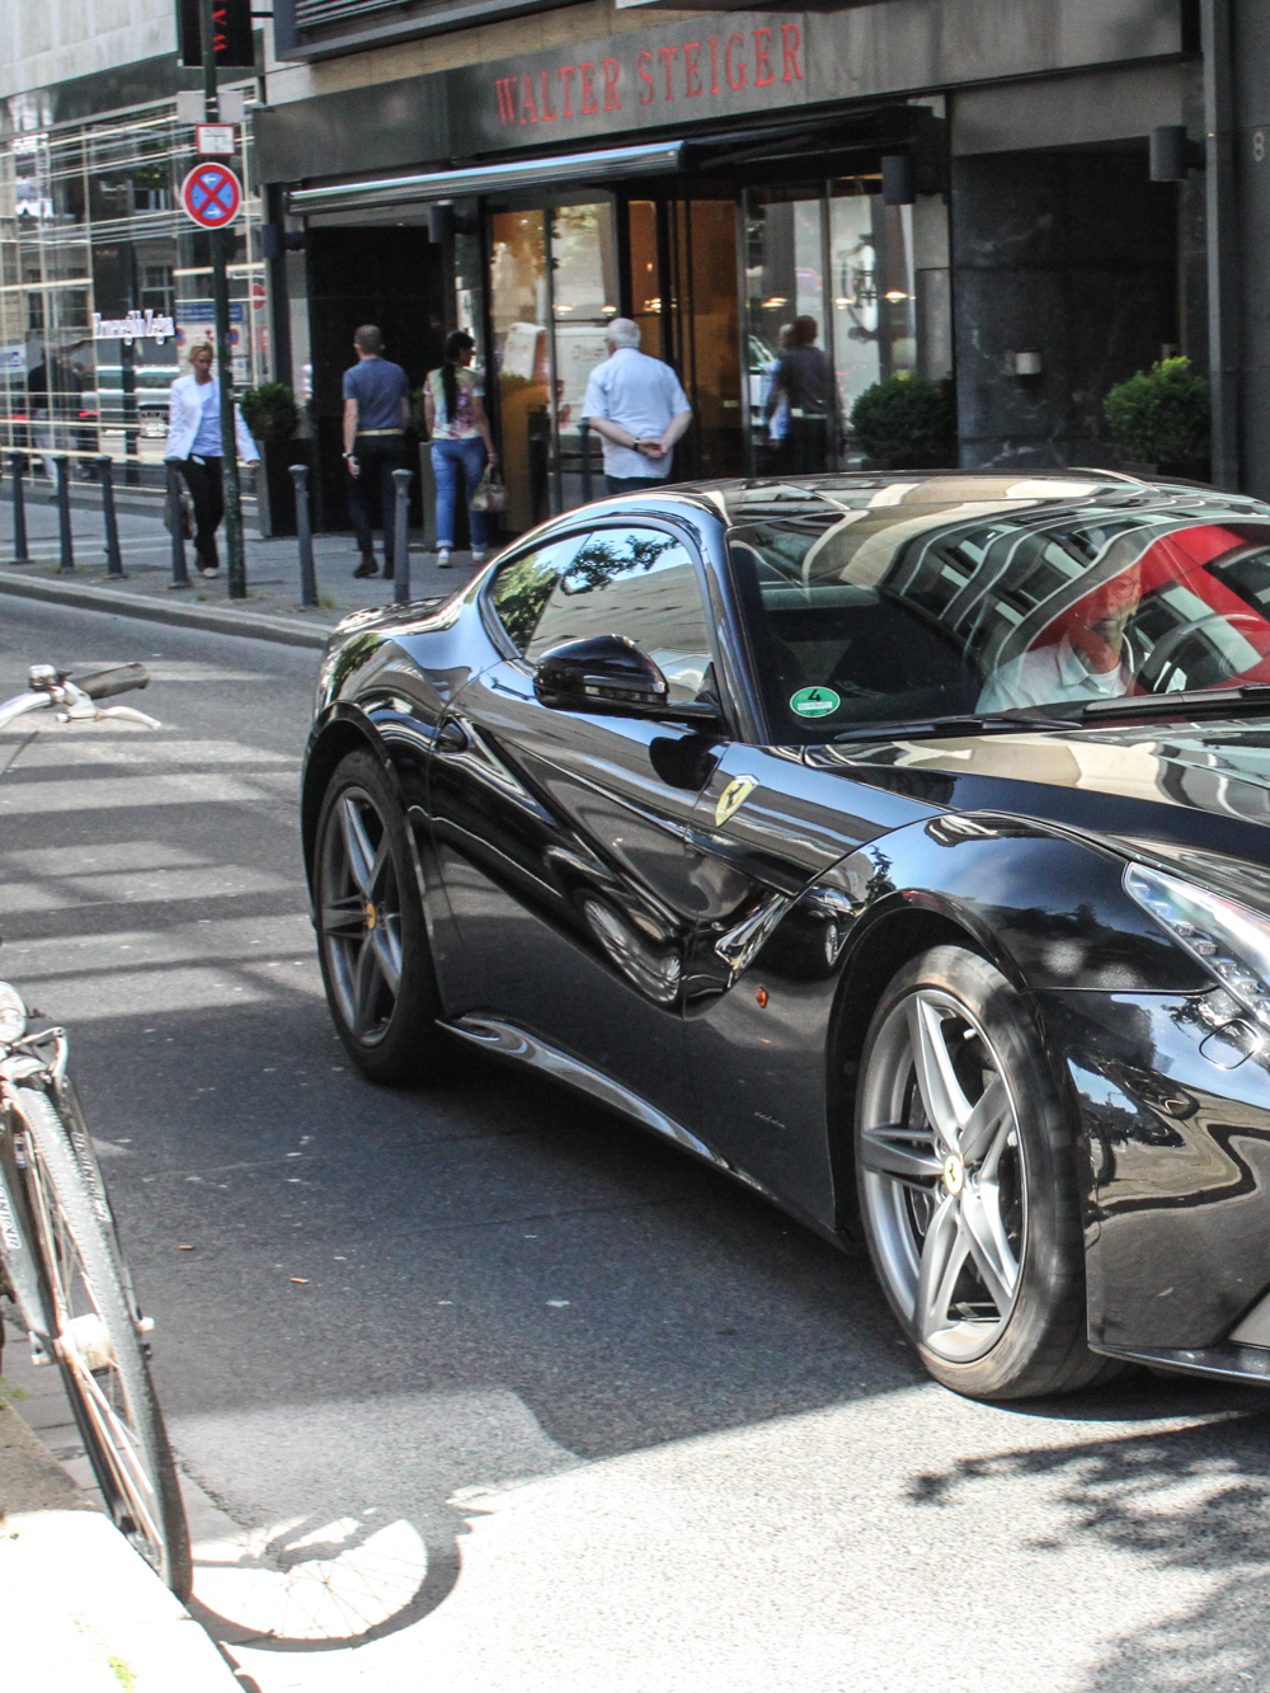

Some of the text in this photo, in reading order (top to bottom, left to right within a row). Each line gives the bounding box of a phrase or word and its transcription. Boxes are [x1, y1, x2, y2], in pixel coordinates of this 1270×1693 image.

[496, 23, 804, 127] WALTER STEIGER
[1253, 131, 1265, 162] 8
[808, 689, 821, 702] 4
